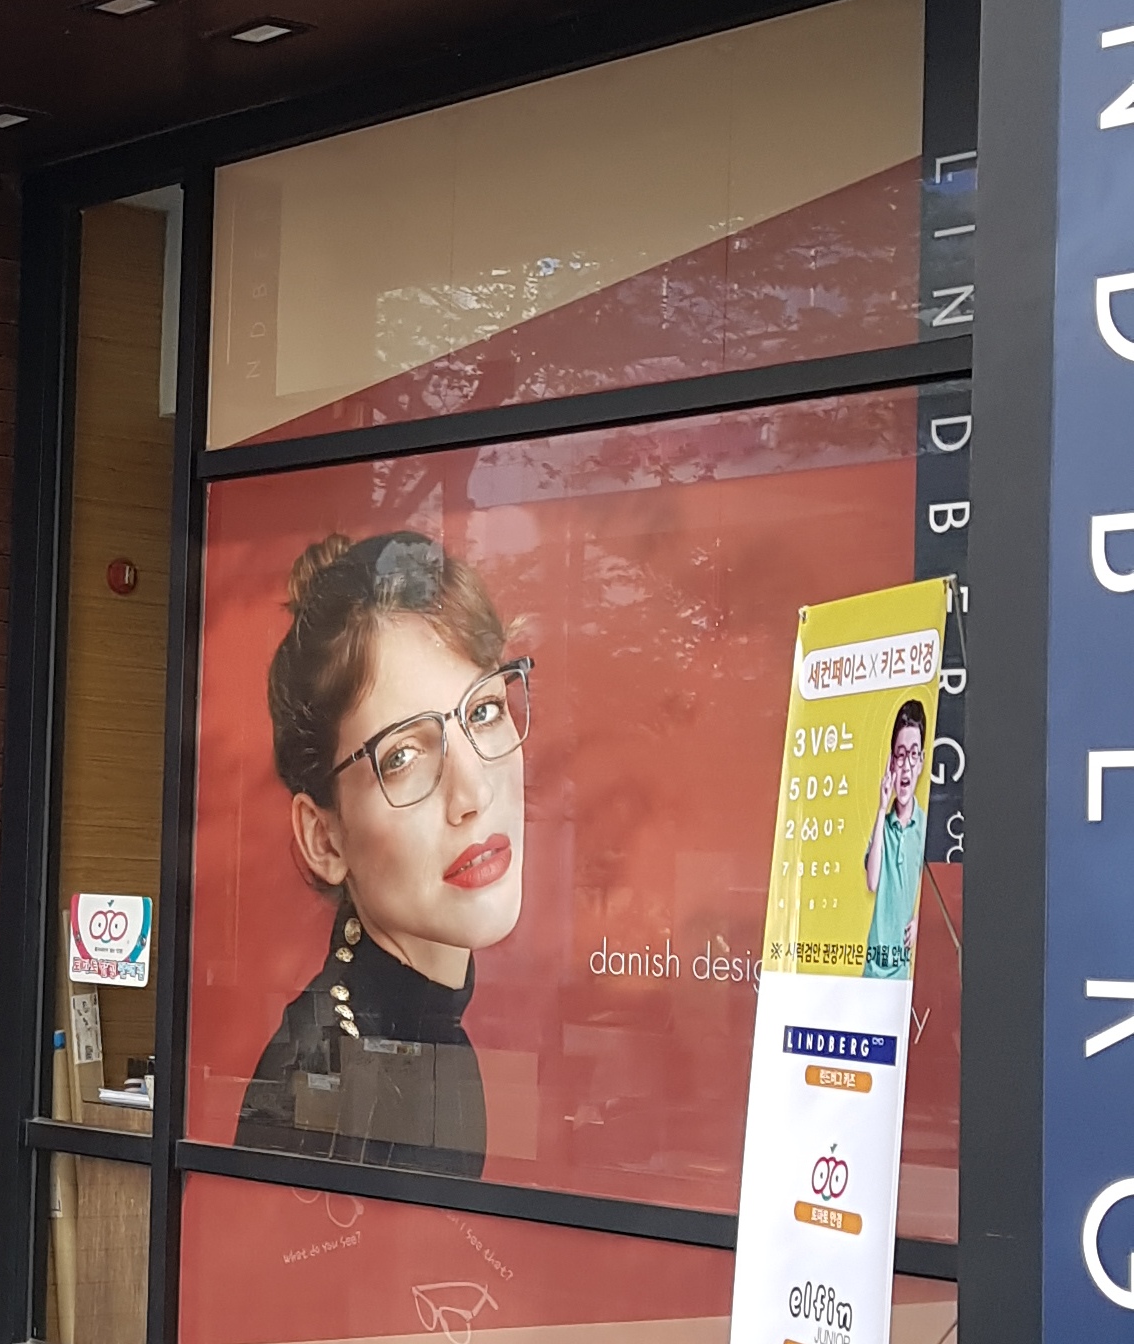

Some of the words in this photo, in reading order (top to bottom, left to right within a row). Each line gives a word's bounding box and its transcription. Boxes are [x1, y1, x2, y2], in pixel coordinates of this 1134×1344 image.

[808, 654, 867, 690] 세컨페이스
[881, 647, 905, 679] 키즈
[910, 640, 934, 675] 안경
[589, 937, 680, 978] danish
[692, 942, 763, 994] desig
[787, 1030, 870, 1057] LINDBERG
[789, 1281, 853, 1332] elfin
